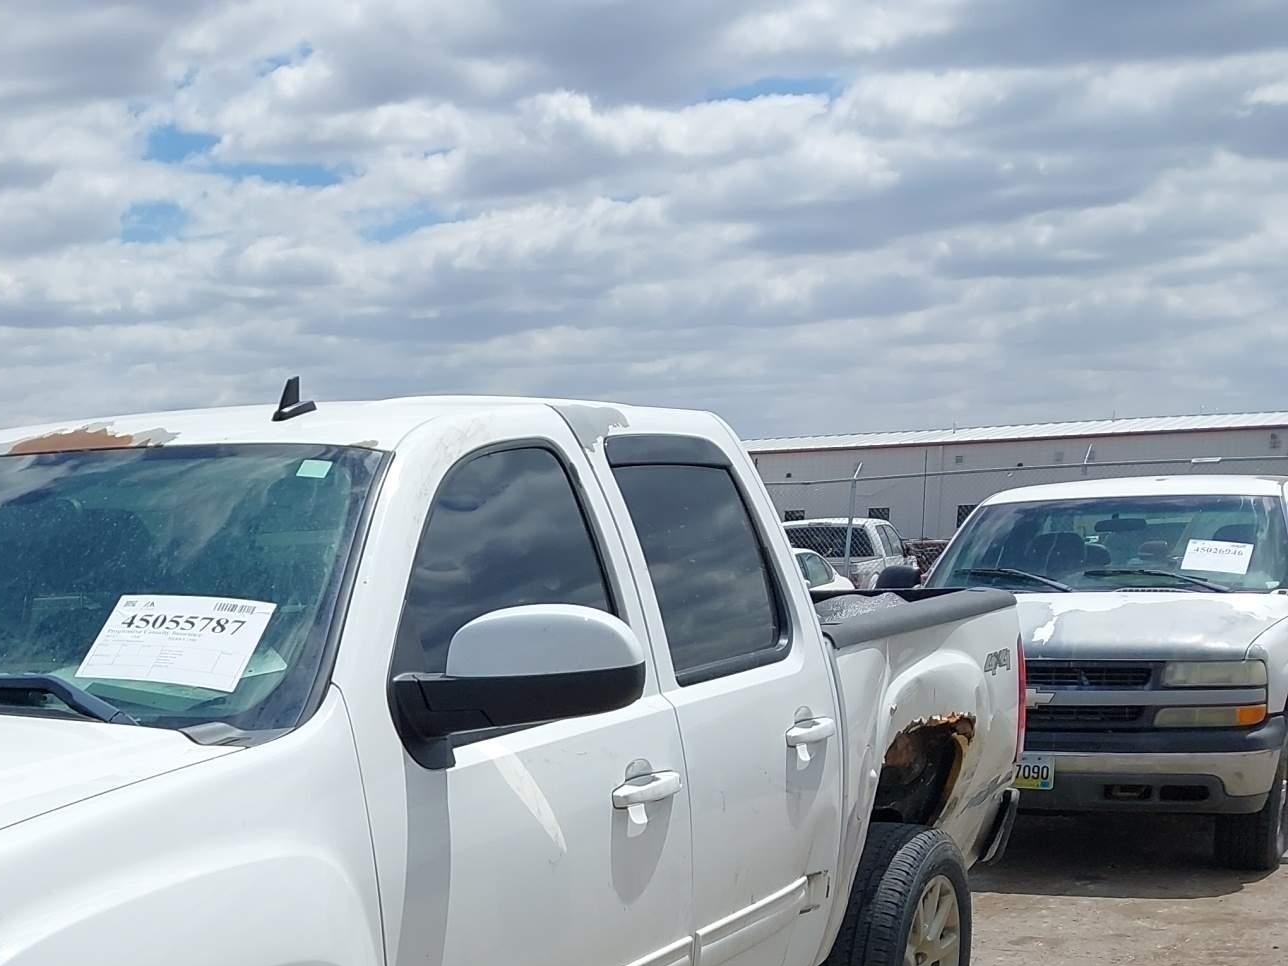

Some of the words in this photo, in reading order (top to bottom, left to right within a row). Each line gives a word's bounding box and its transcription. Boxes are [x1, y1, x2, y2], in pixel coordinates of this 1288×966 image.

[1193, 546, 1244, 557] 45026946
[121, 613, 247, 636] 45055787
[1016, 764, 1050, 780] 7090
